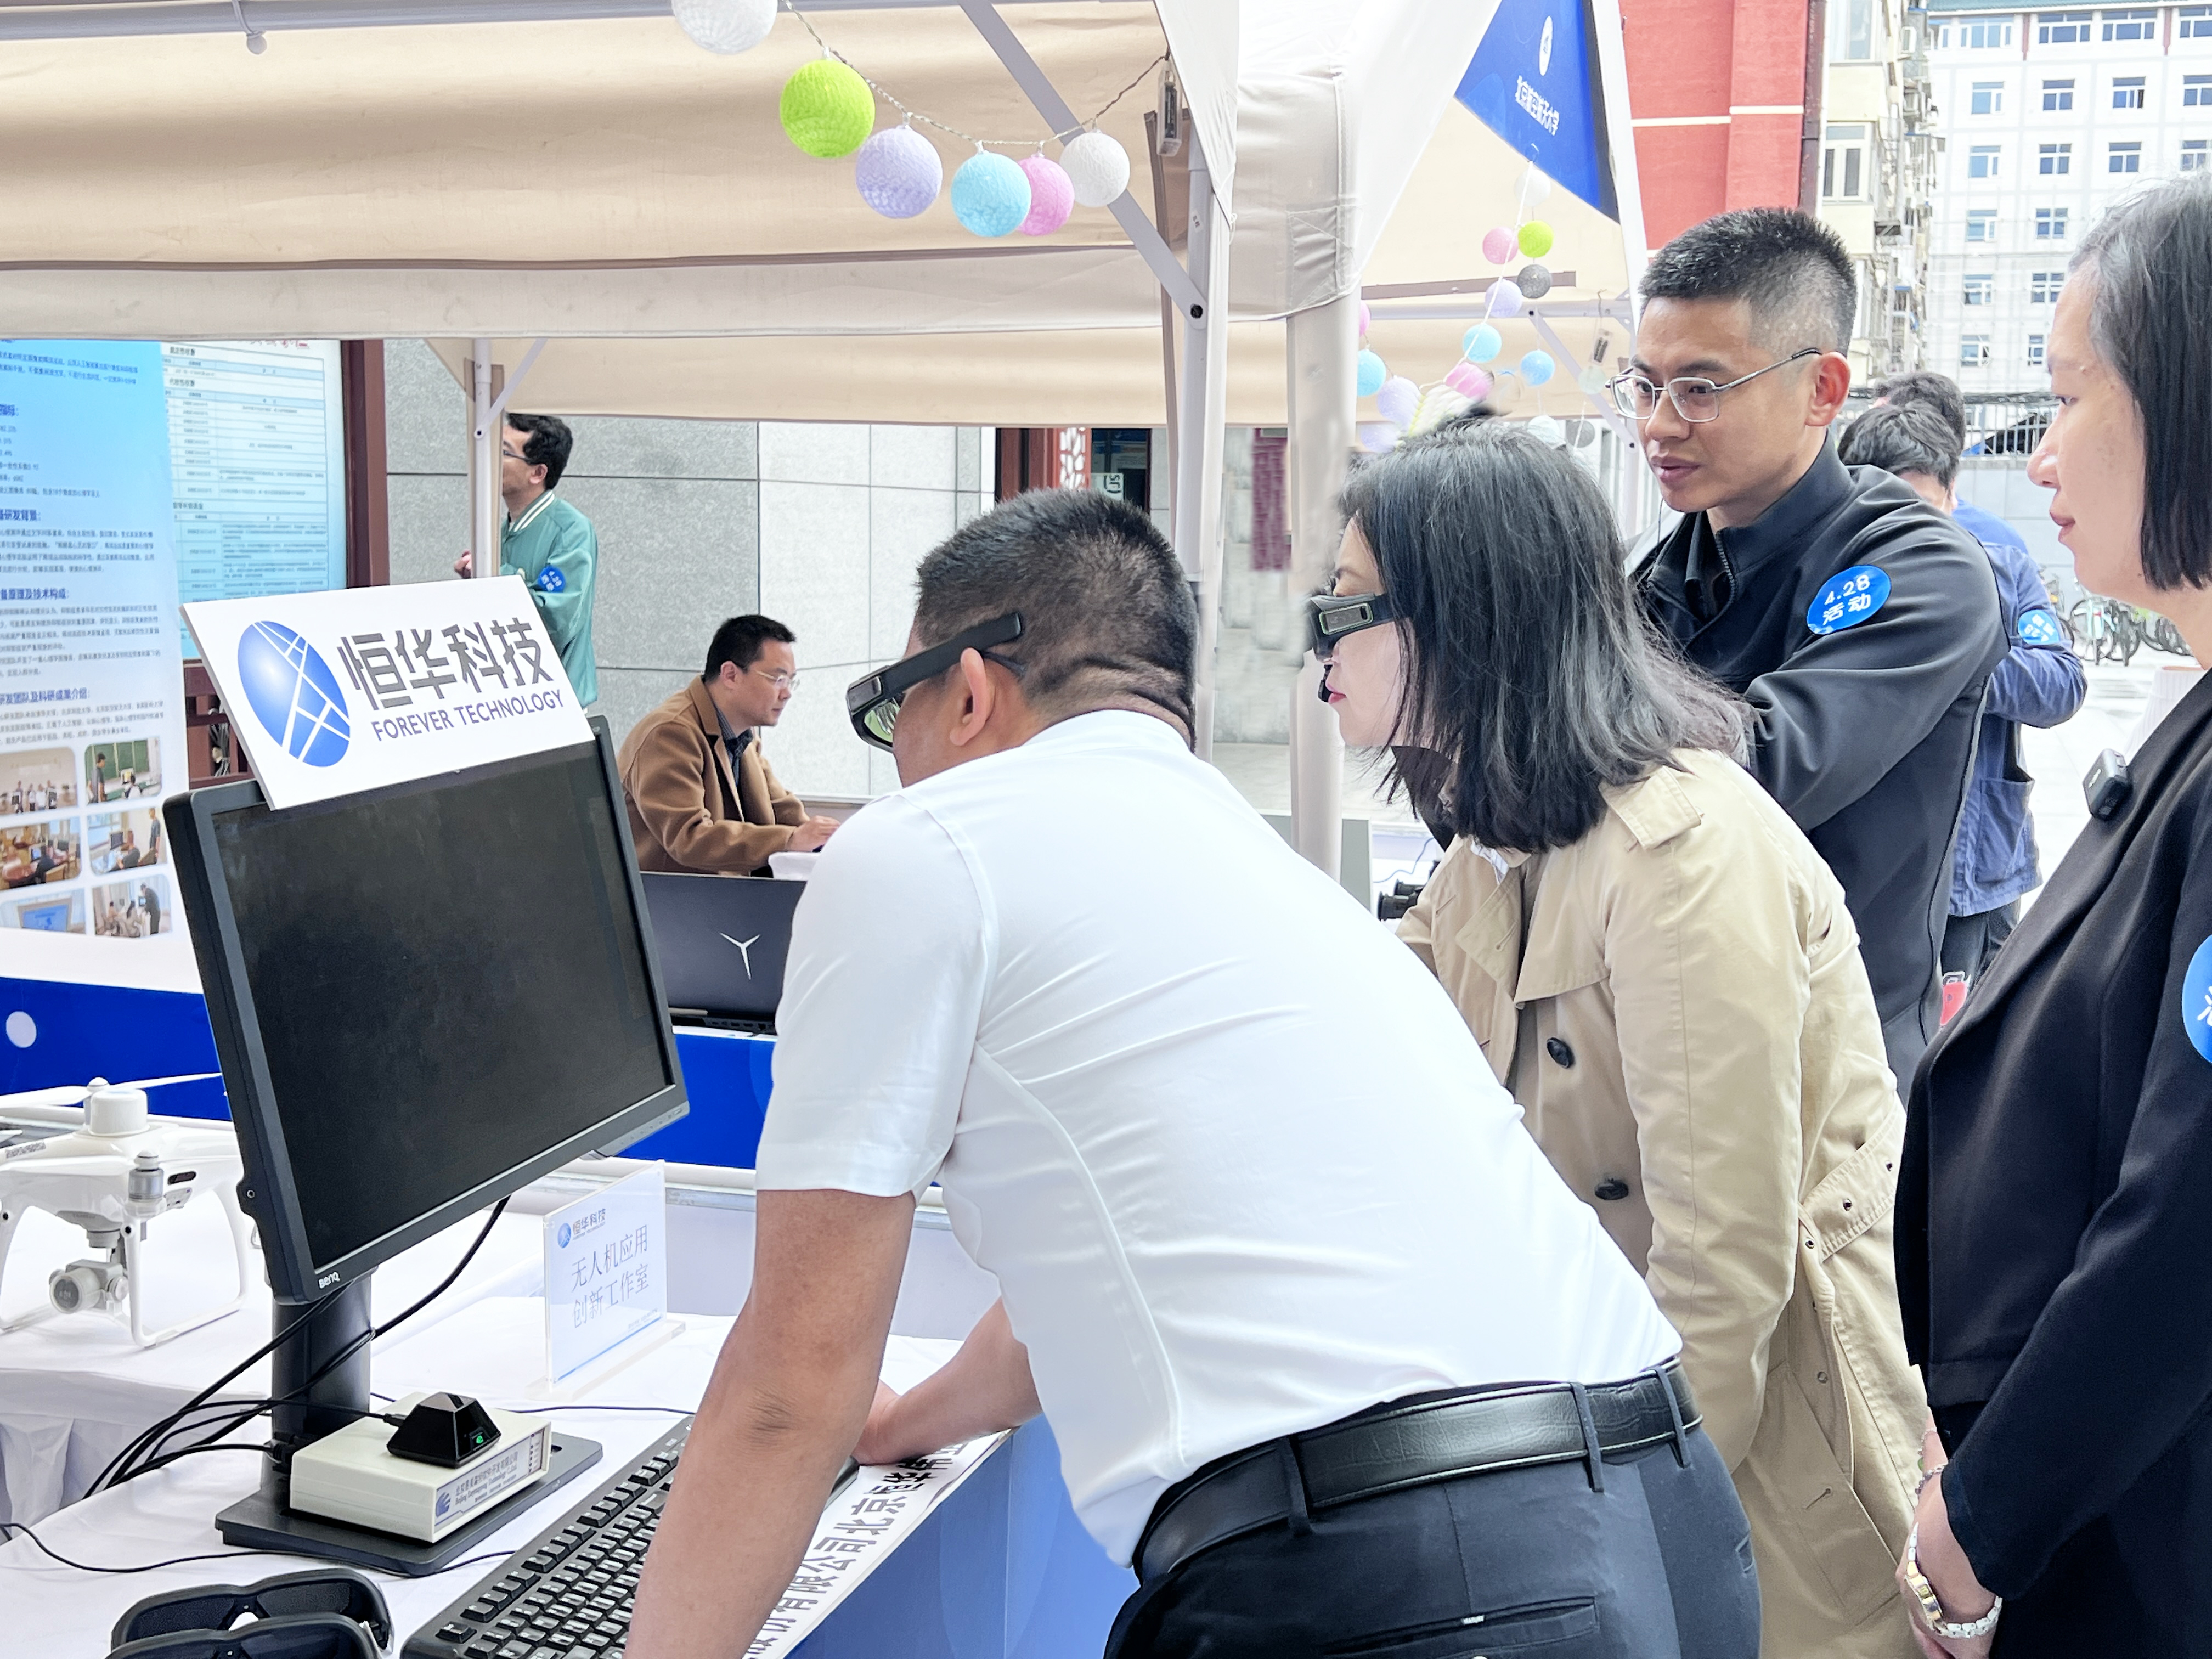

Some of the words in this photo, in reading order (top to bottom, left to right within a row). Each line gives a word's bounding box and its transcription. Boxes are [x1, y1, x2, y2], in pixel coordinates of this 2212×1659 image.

[1822, 593, 1871, 625] 活动
[1824, 574, 1870, 605] 4.28
[336, 617, 554, 711] 恒华科技
[370, 709, 455, 741] FOREVER
[453, 689, 564, 726] TECHNOLOGY
[573, 1208, 606, 1235] 恒华科技
[571, 1224, 648, 1293] 无人机应用
[318, 1271, 340, 1289] BenQ
[572, 1263, 650, 1328] 创新工作室
